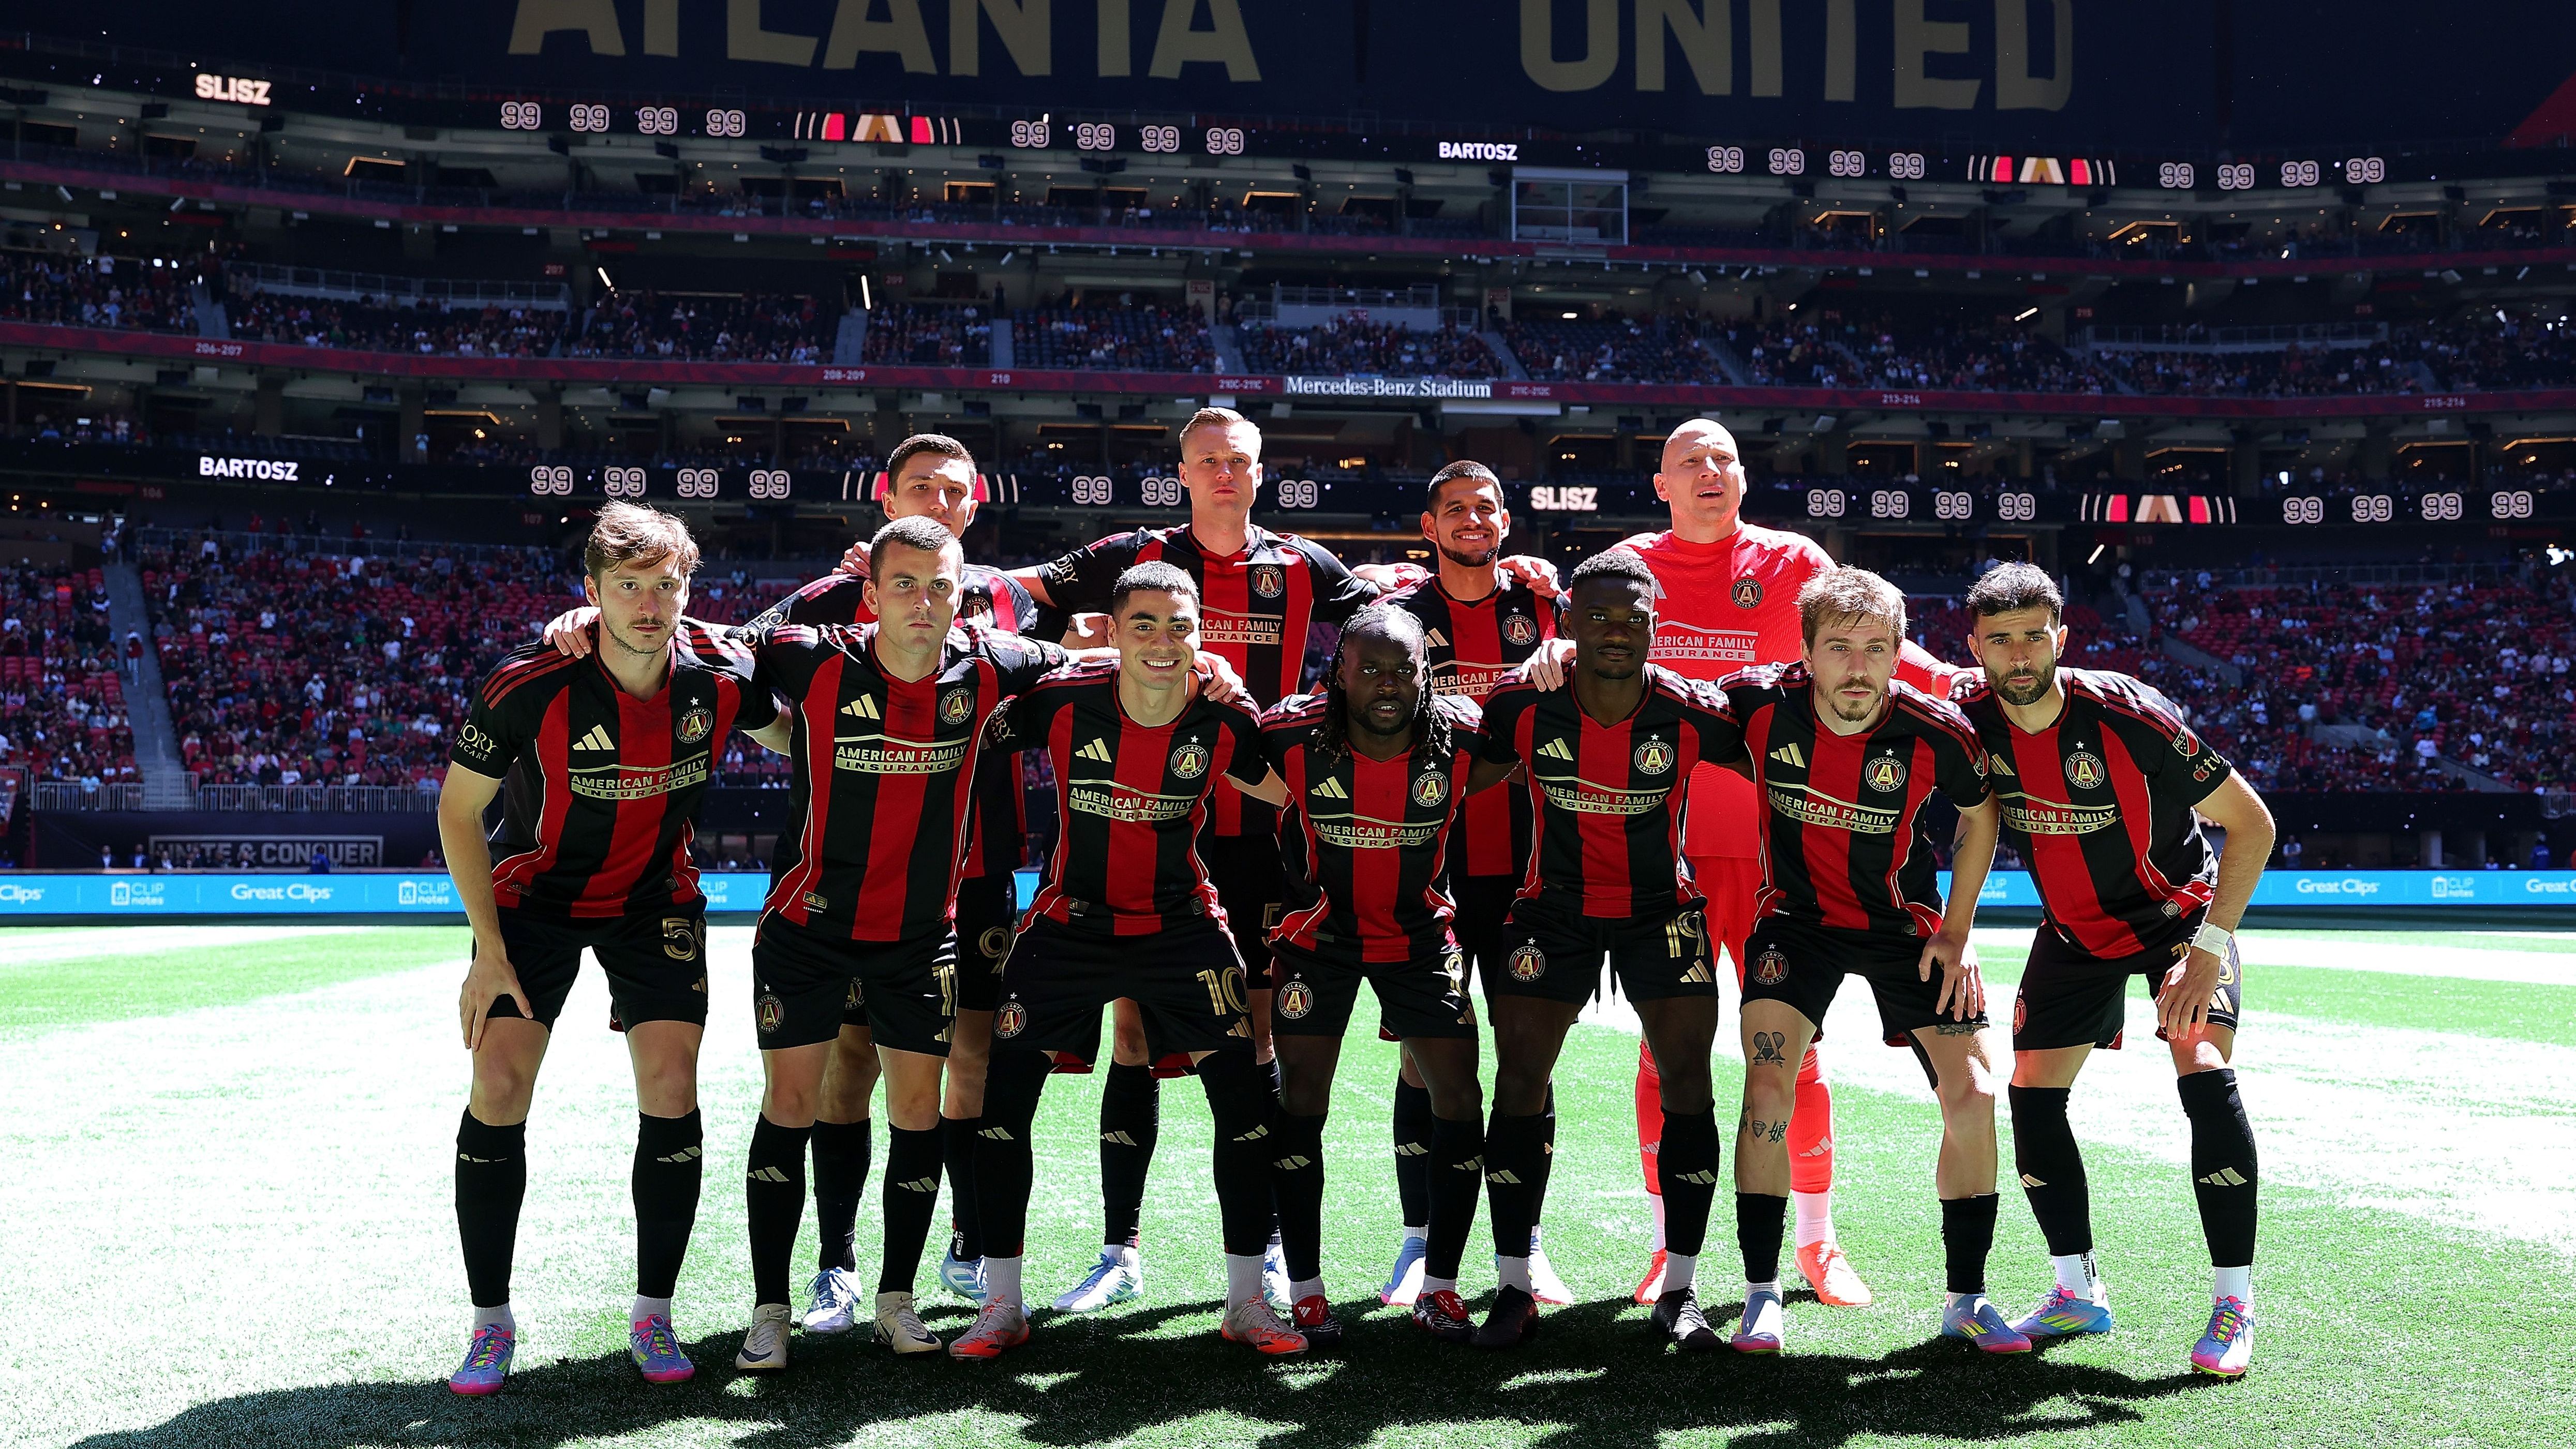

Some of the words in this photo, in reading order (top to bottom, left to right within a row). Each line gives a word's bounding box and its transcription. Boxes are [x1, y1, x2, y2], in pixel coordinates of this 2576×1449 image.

[195, 73, 272, 106] SLISZ
[501, 102, 541, 129] 99
[570, 104, 609, 132] 99
[638, 107, 677, 134] 99
[707, 110, 745, 137] 99
[1011, 121, 1049, 147] 99
[1077, 123, 1114, 150] 99
[1141, 126, 1179, 152] 99
[1207, 128, 1244, 154] 99
[1439, 142, 1518, 161] BARTOSZ
[1707, 146, 1743, 172] 99
[1769, 148, 1804, 174] 99
[1829, 151, 1864, 176] 99
[1889, 153, 1924, 178] 99
[2160, 163, 2194, 188] 99
[2218, 164, 2254, 189] 99
[2281, 161, 2319, 186] 99
[2346, 157, 2384, 183] 99
[196, 342, 243, 356] 206-207
[1286, 377, 1416, 397] Mercedes-Benz
[1420, 379, 1491, 398] Stadium
[1882, 393, 1921, 405] 213-214
[200, 456, 299, 481] BARTOSZ
[531, 466, 573, 495] 99
[605, 467, 646, 497] 99
[677, 469, 718, 497] 99
[750, 470, 790, 499] 99
[1073, 476, 1112, 504] 99
[1141, 477, 1181, 505] 99
[1278, 480, 1317, 508] 99
[1530, 486, 1598, 511] SLISZ
[1808, 489, 1844, 517] 99
[1872, 491, 1909, 518] 99
[1935, 492, 1972, 519] 99
[1999, 493, 2035, 520] 99
[2283, 497, 2323, 524] 99
[2352, 495, 2392, 522] 99
[2421, 493, 2462, 520] 99
[2492, 491, 2533, 518] 99
[1255, 566, 1278, 575] ATLANTA
[1736, 580, 1759, 588] ATLANTA
[1256, 587, 1274, 596] UNITED
[1734, 599, 1751, 607] UNITED
[1201, 620, 1232, 630] ICAN
[1238, 620, 1281, 632] FAMILY
[1204, 632, 1273, 641] URANCE
[1648, 636, 1703, 647] MERICAN
[1708, 637, 1756, 649] FAMILY
[1431, 672, 1487, 688] MERICAN
[946, 690, 970, 700] ATLANTA
[682, 709, 708, 721] ATLANTA
[943, 714, 962, 723] UNITED
[1641, 741, 1667, 751] ATLANTA
[2175, 735, 2186, 748] MLS
[836, 746, 915, 762] AMERICAN
[920, 744, 966, 761] FAMILY
[1178, 745, 1204, 755] ATLANTA
[1873, 757, 1901, 767] ATLANTA
[2070, 753, 2096, 763] ATLANTA
[2203, 750, 2221, 772] tv
[845, 760, 957, 772] INSURANCE
[1174, 767, 1193, 776] UNITED
[1639, 765, 1660, 773] UNITED
[571, 775, 653, 789] AMERICAN
[659, 758, 706, 783] FAMILY
[1419, 772, 1444, 782] ATLANTA
[579, 776, 697, 798] INSURANCE
[1868, 778, 1890, 790] UNITED
[2072, 776, 2094, 787] UNITED
[1070, 787, 1141, 809] AMERICAN
[1145, 800, 1194, 811] FAMILY
[1540, 782, 1610, 803] AMERICAN
[1615, 793, 1666, 805] FAMILY
[1417, 797, 1436, 805] UNITED
[1768, 787, 1838, 817] AMERICAN
[1842, 809, 1896, 826] FAMILY
[1078, 802, 1181, 819] INSURANCE
[1776, 801, 1882, 832] INSURANCE
[2061, 810, 2114, 823] FAMILY
[1313, 821, 1386, 838] AMERICAN
[1390, 825, 1440, 838] FAMILY
[131, 882, 165, 896] CLIP
[418, 882, 451, 895] CLIP
[2296, 878, 2341, 894] Great
[2341, 878, 2378, 898] Clips
[2449, 877, 2473, 889] CLIP
[2525, 878, 2569, 893] Great
[231, 883, 285, 900] Great
[287, 883, 331, 904] Clips
[418, 895, 450, 905] notes
[131, 897, 165, 905] notes
[1665, 912, 1705, 958] 19
[1196, 966, 1250, 1015] 10
